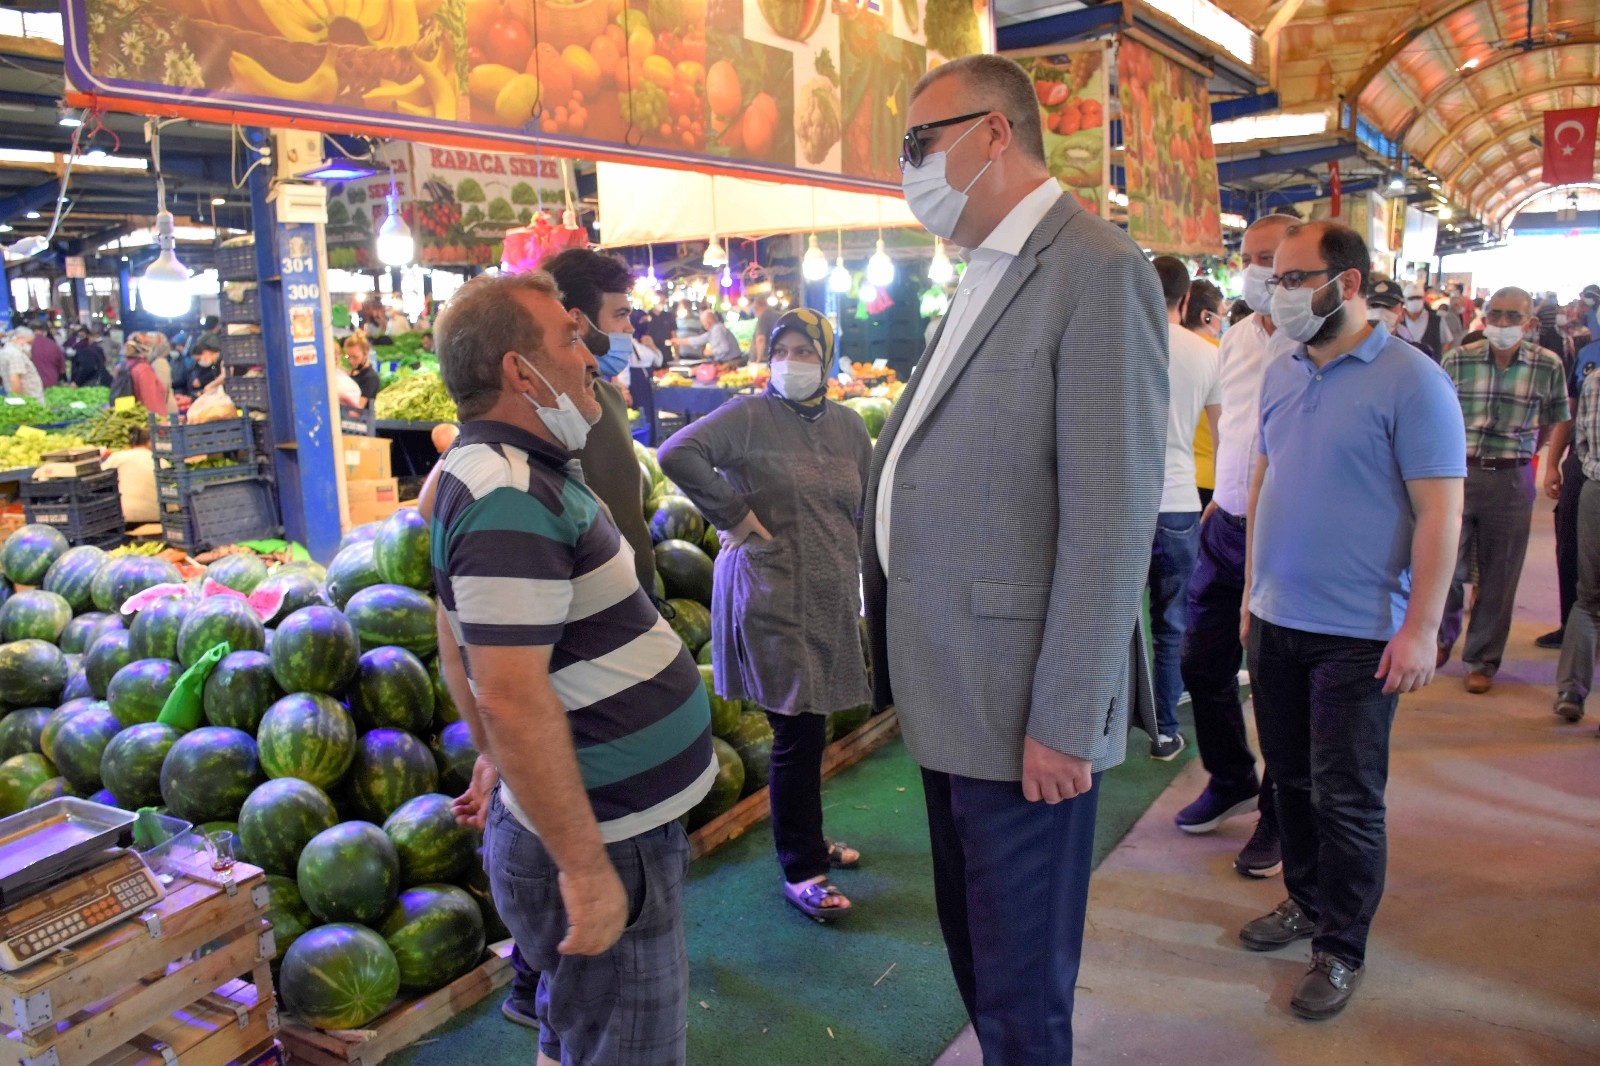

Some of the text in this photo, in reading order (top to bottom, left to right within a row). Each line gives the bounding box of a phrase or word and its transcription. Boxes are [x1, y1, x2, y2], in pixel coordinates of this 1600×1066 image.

[429, 148, 507, 175] KARACA
[282, 258, 313, 274] 301
[288, 284, 319, 300] 300
